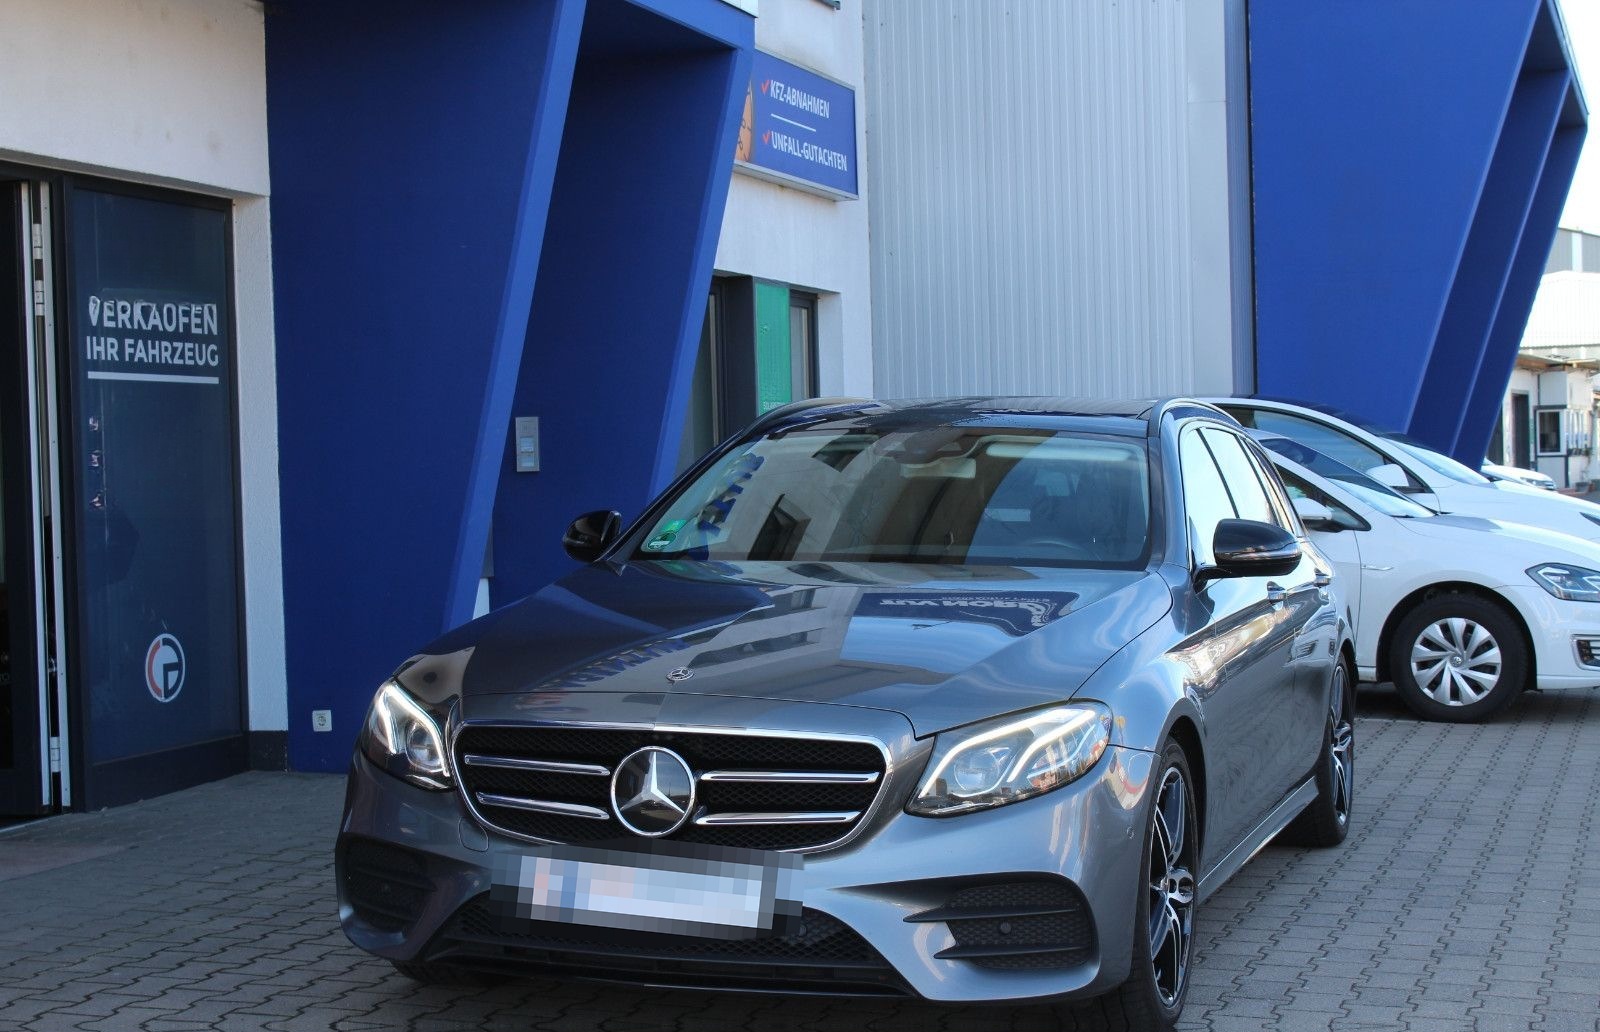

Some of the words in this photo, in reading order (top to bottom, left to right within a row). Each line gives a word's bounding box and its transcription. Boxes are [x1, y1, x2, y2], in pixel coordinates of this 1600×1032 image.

[770, 79, 830, 119] KFZ-ABNAHMEN
[771, 130, 848, 172] UNFALL-GUTACHTEN
[86, 336, 119, 361] IHR
[124, 338, 219, 367] FAHRZEUG
